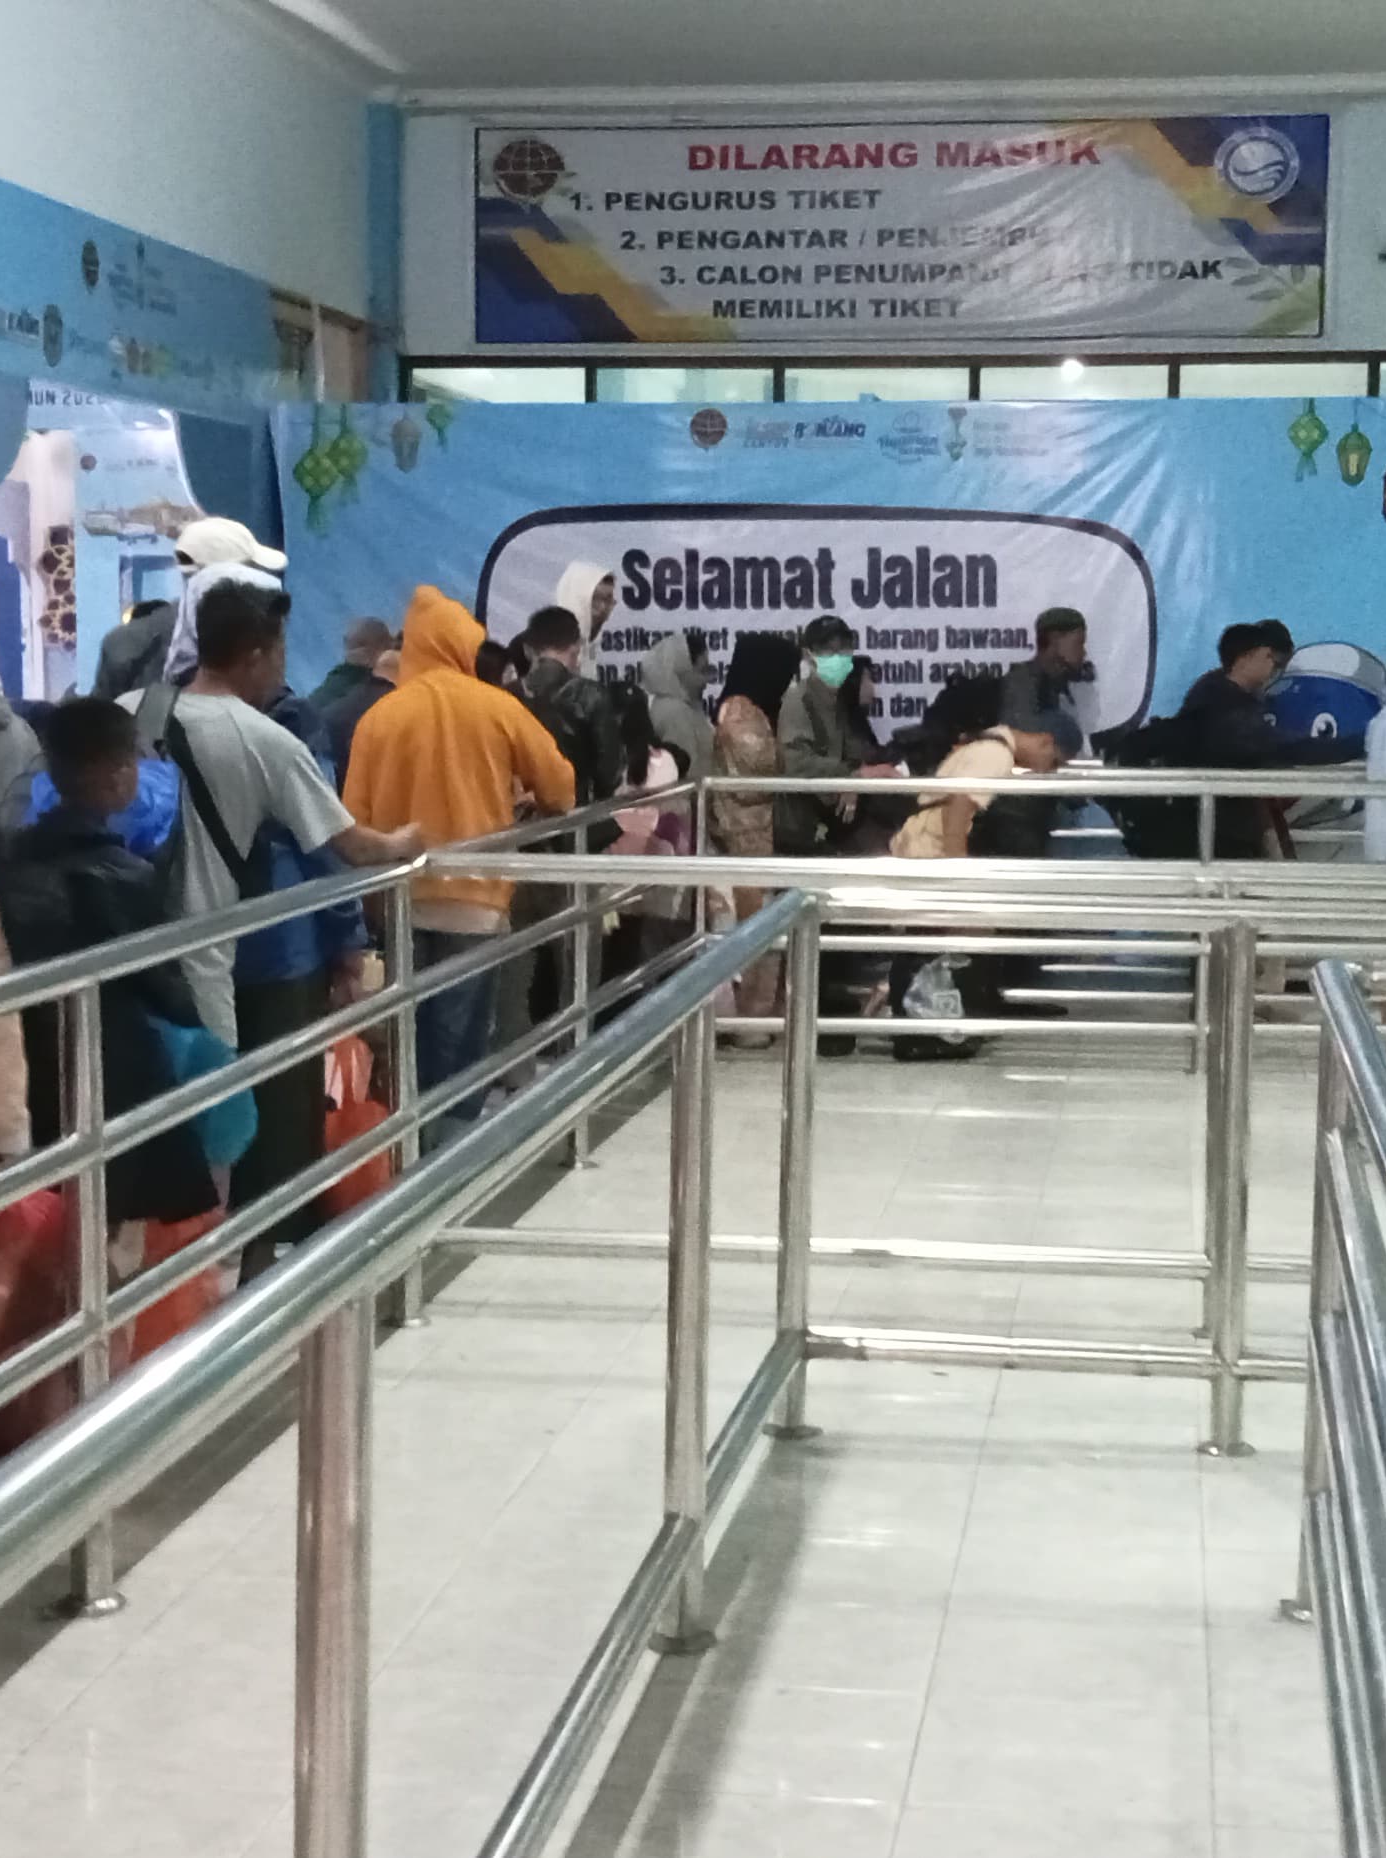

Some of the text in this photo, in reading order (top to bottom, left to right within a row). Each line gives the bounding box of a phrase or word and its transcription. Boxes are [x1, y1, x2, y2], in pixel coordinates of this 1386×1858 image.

[688, 140, 1101, 170] DILARANG MASUK
[570, 189, 882, 211] 1. PENGURUS TIKET
[620, 230, 646, 250] 2.
[657, 229, 848, 249] PENGANTAR
[660, 265, 686, 285] 3.
[697, 265, 802, 285] CALON
[1129, 259, 1224, 281] TIDAK
[713, 298, 962, 319] MEMILIKI TIKET
[621, 546, 998, 611] Selamat Jalan
[866, 625, 939, 652] barang
[945, 625, 1034, 652] bawaan,
[871, 659, 923, 684] atuhi
